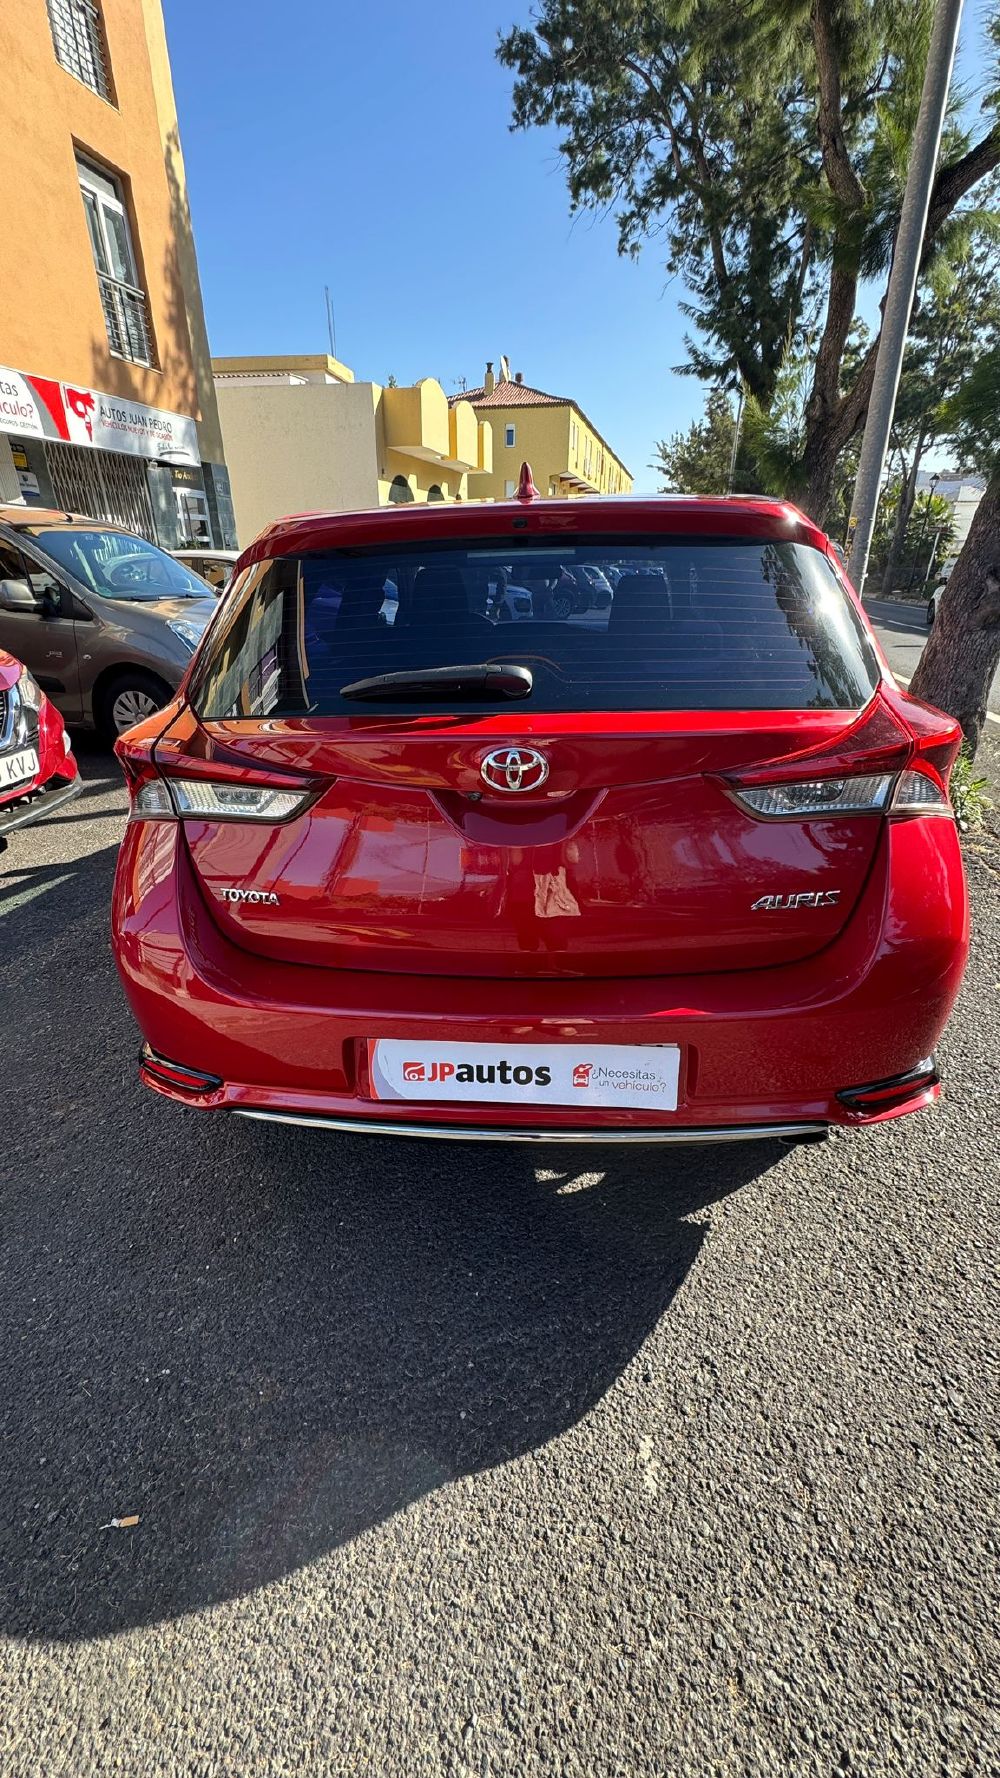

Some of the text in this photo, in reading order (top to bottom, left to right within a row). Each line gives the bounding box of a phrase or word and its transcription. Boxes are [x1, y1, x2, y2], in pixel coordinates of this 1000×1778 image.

[100, 406, 173, 433] AUTOS JUAN PEDRO
[6, 752, 35, 779] KVJ
[220, 888, 280, 906] TOYOTA
[751, 890, 840, 910] AURIS
[428, 1060, 552, 1086] JPautos
[592, 1067, 656, 1081] ¿Necesitas
